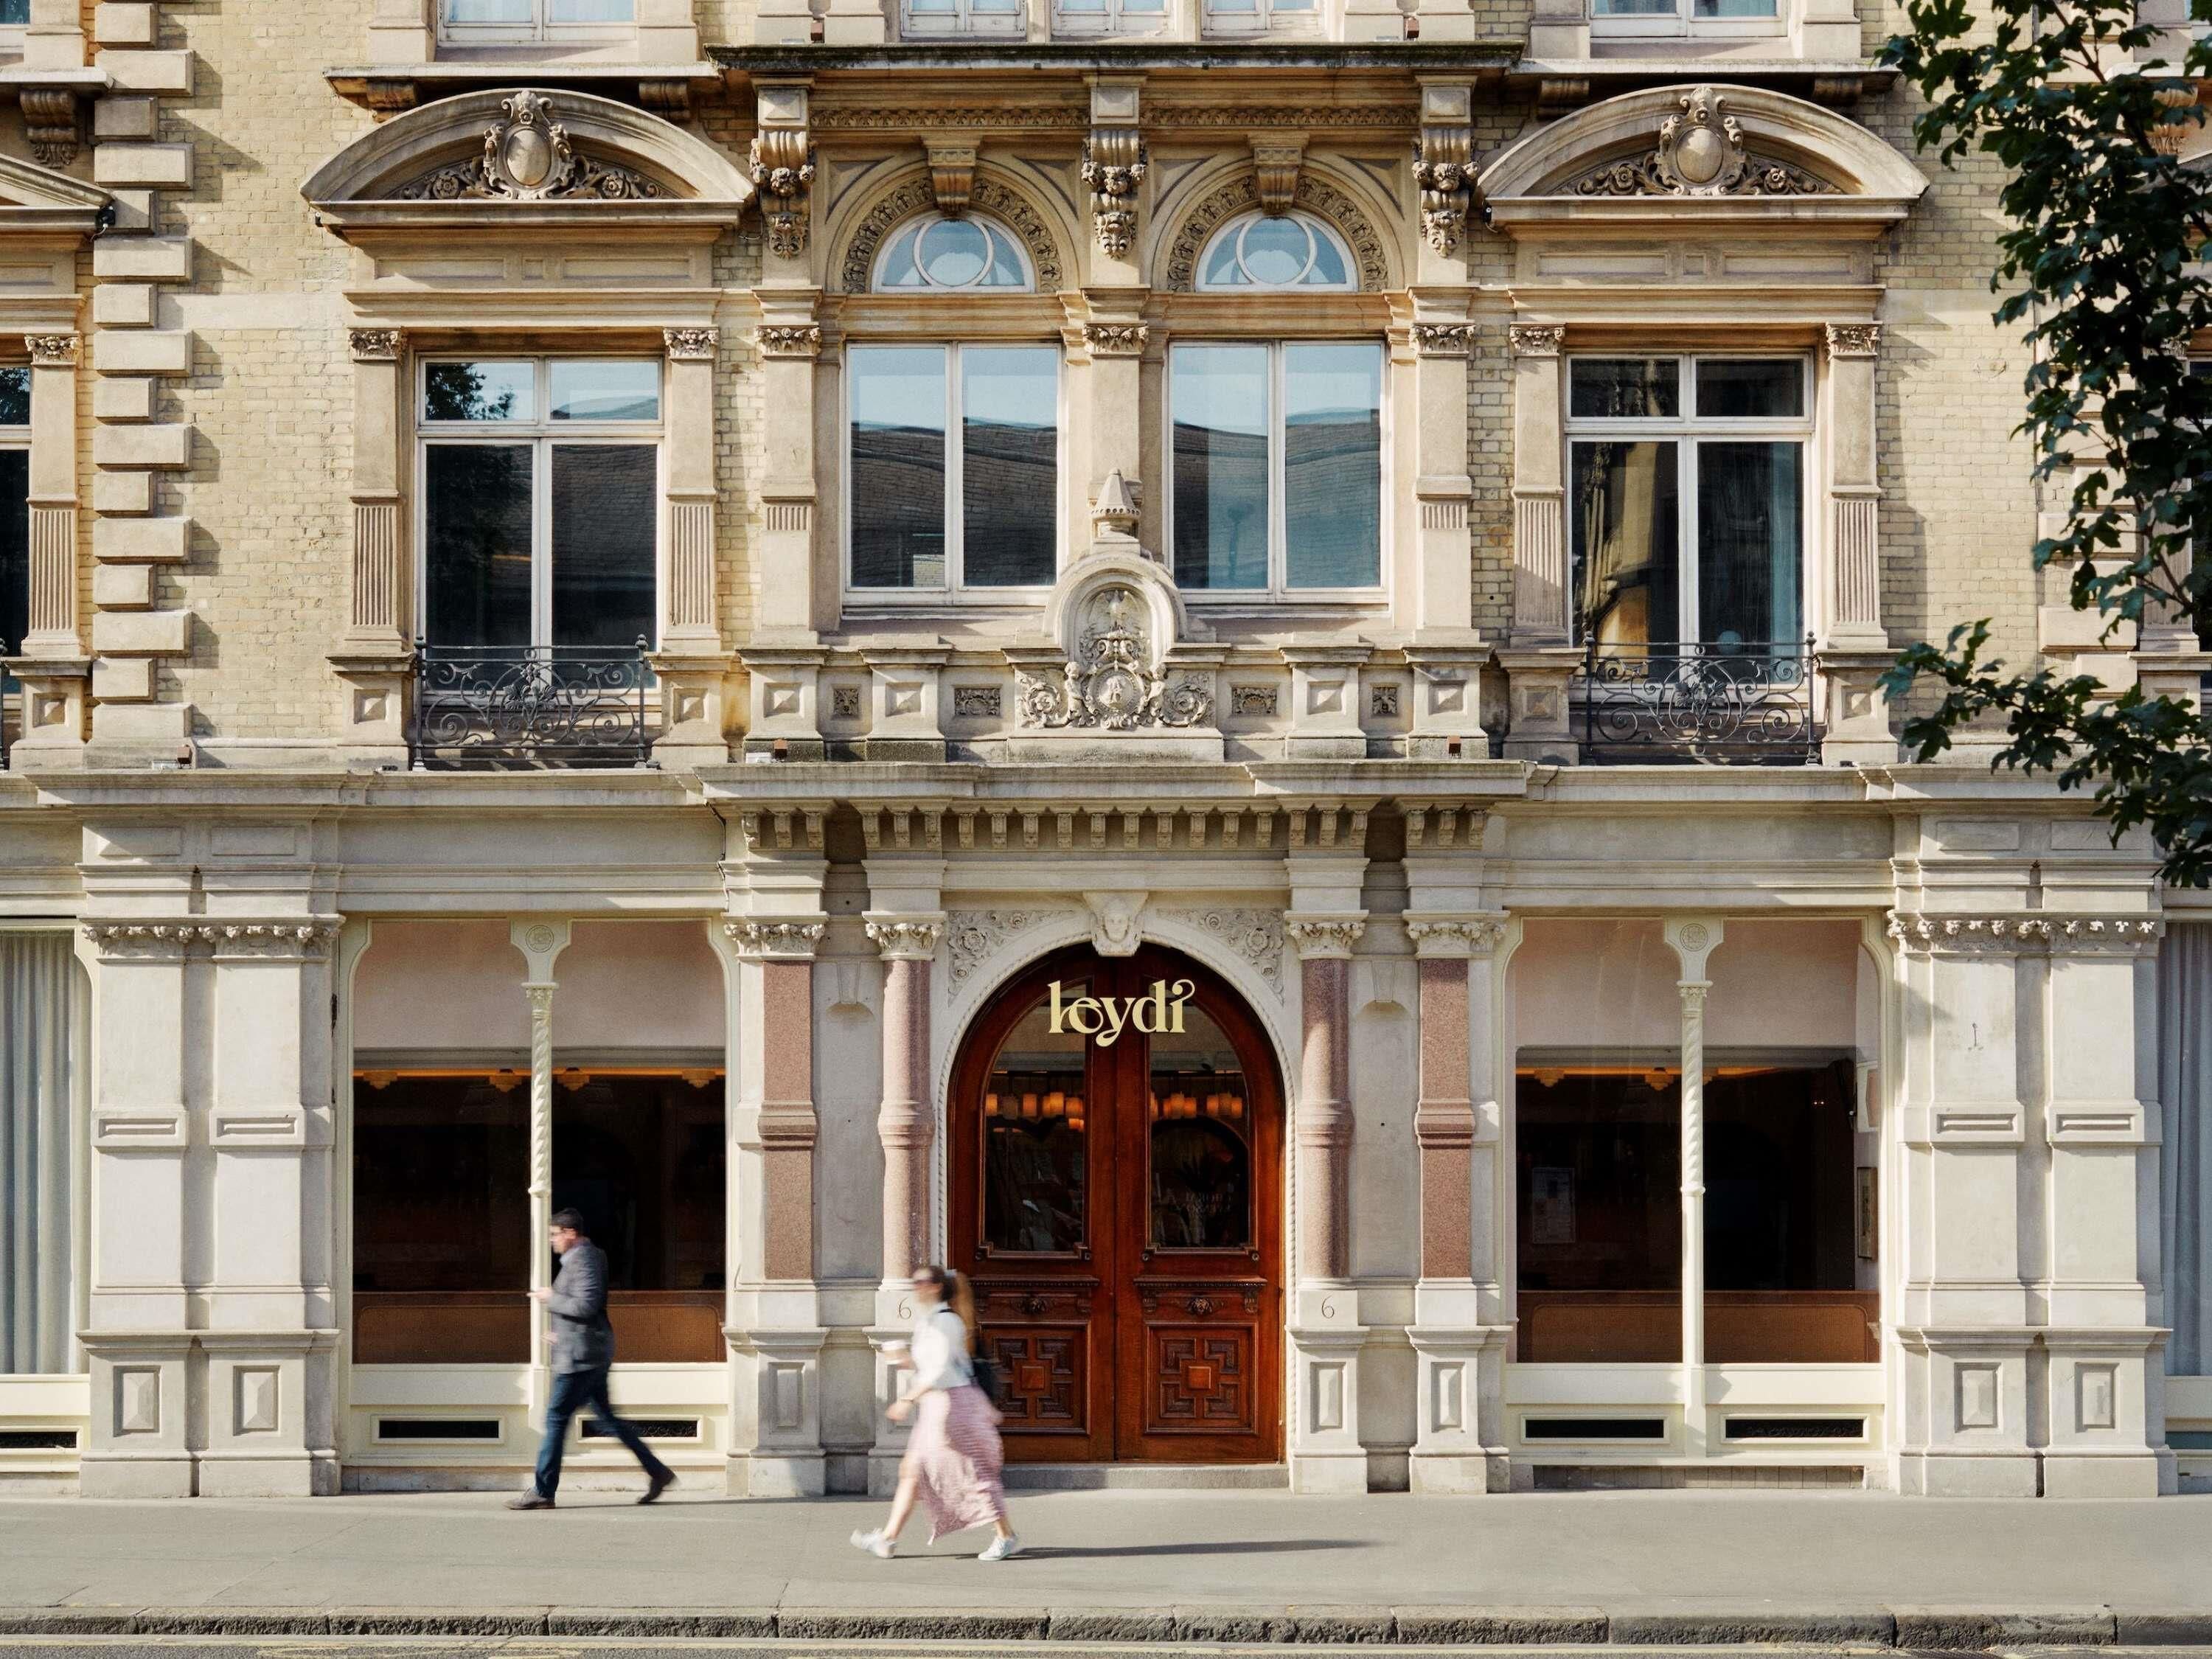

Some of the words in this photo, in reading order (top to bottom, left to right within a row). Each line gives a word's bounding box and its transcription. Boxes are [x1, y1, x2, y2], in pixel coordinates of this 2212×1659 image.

[1048, 979, 1195, 1047] leydi
[899, 1297, 912, 1320] 6
[1321, 1295, 1335, 1319] 6
